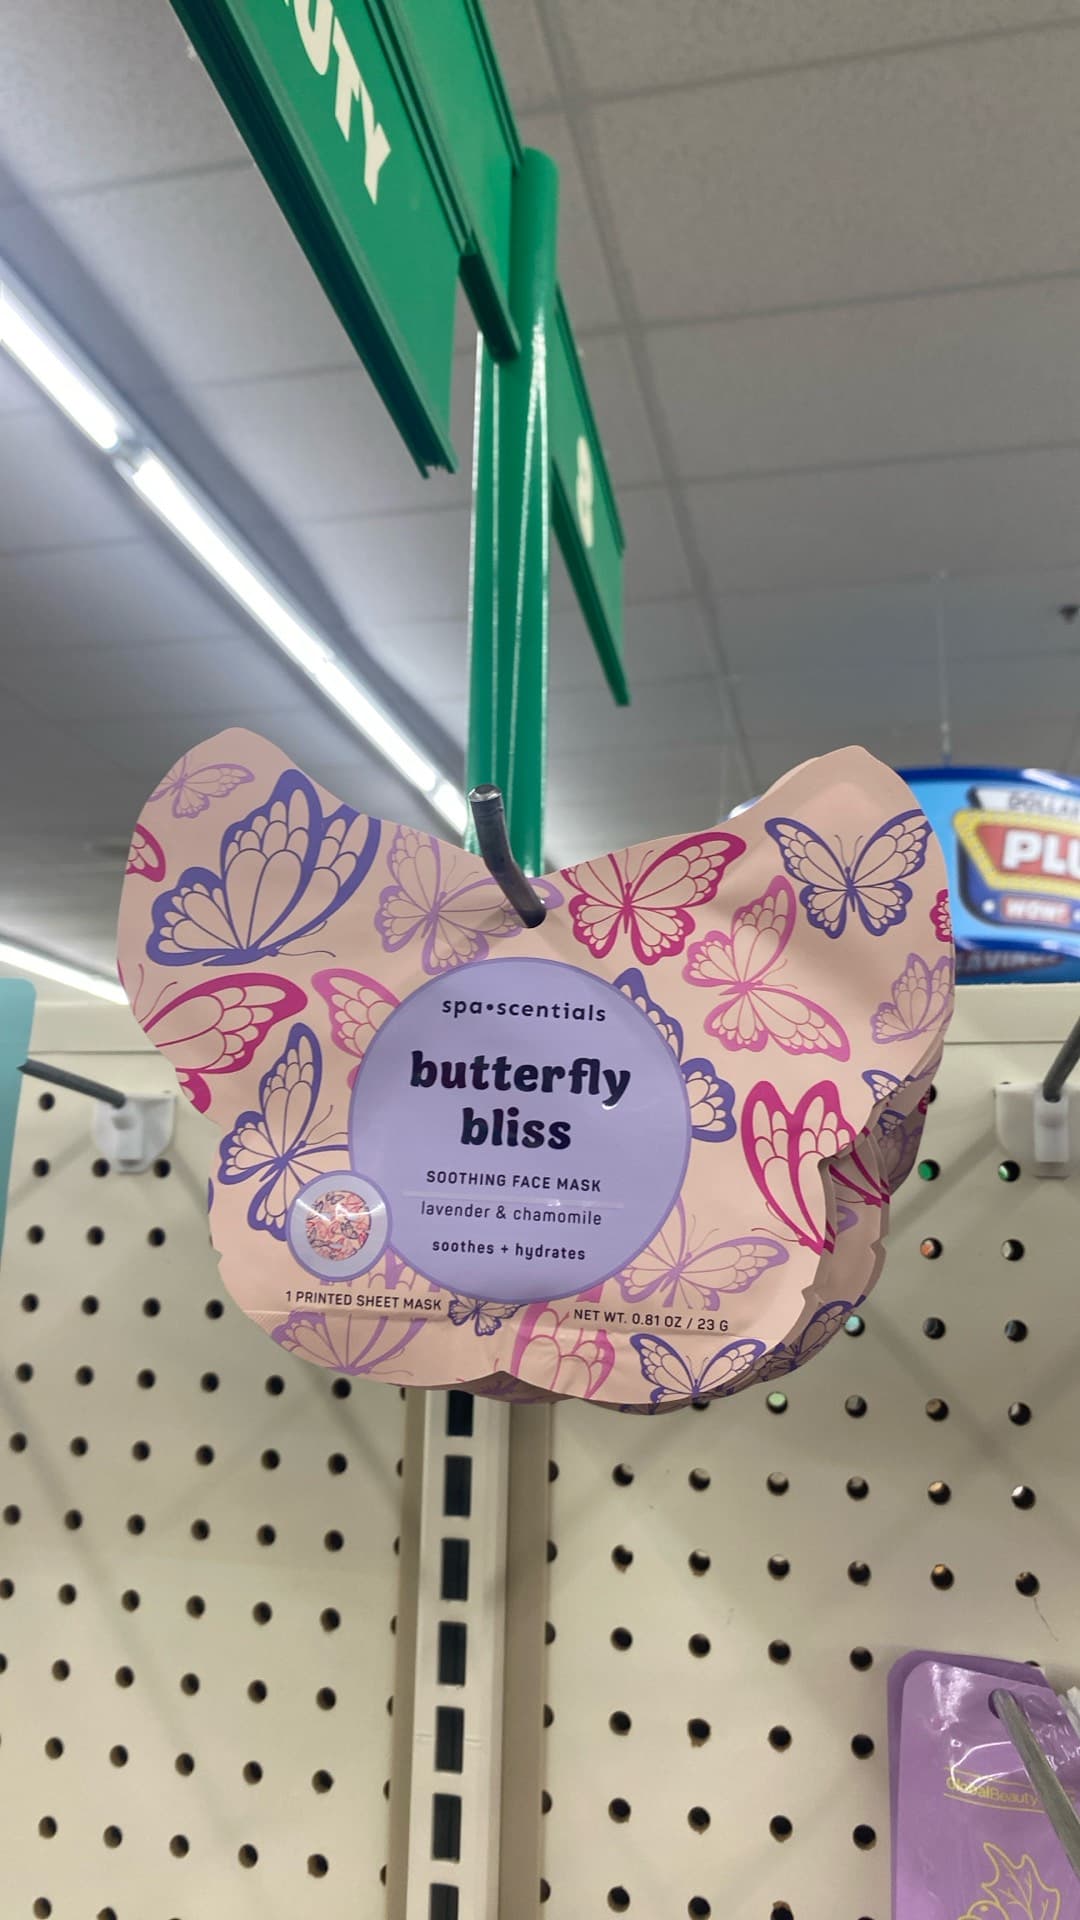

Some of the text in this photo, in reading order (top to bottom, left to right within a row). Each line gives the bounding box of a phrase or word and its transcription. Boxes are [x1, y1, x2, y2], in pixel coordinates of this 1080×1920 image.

[284, 0, 392, 205] UTY
[410, 1050, 631, 1107] butterfly
[461, 1106, 572, 1150] bliss
[426, 1170, 601, 1193] SOOTHING FACE MASK
[421, 1200, 602, 1226] lavender & chamomile
[432, 1239, 494, 1255] soothes
[515, 1242, 586, 1261] hydrates
[285, 1290, 442, 1311] 1 PRINTED SHEET MASK
[573, 1309, 729, 1332] NET WT. 0.81 OZ / 23 G
